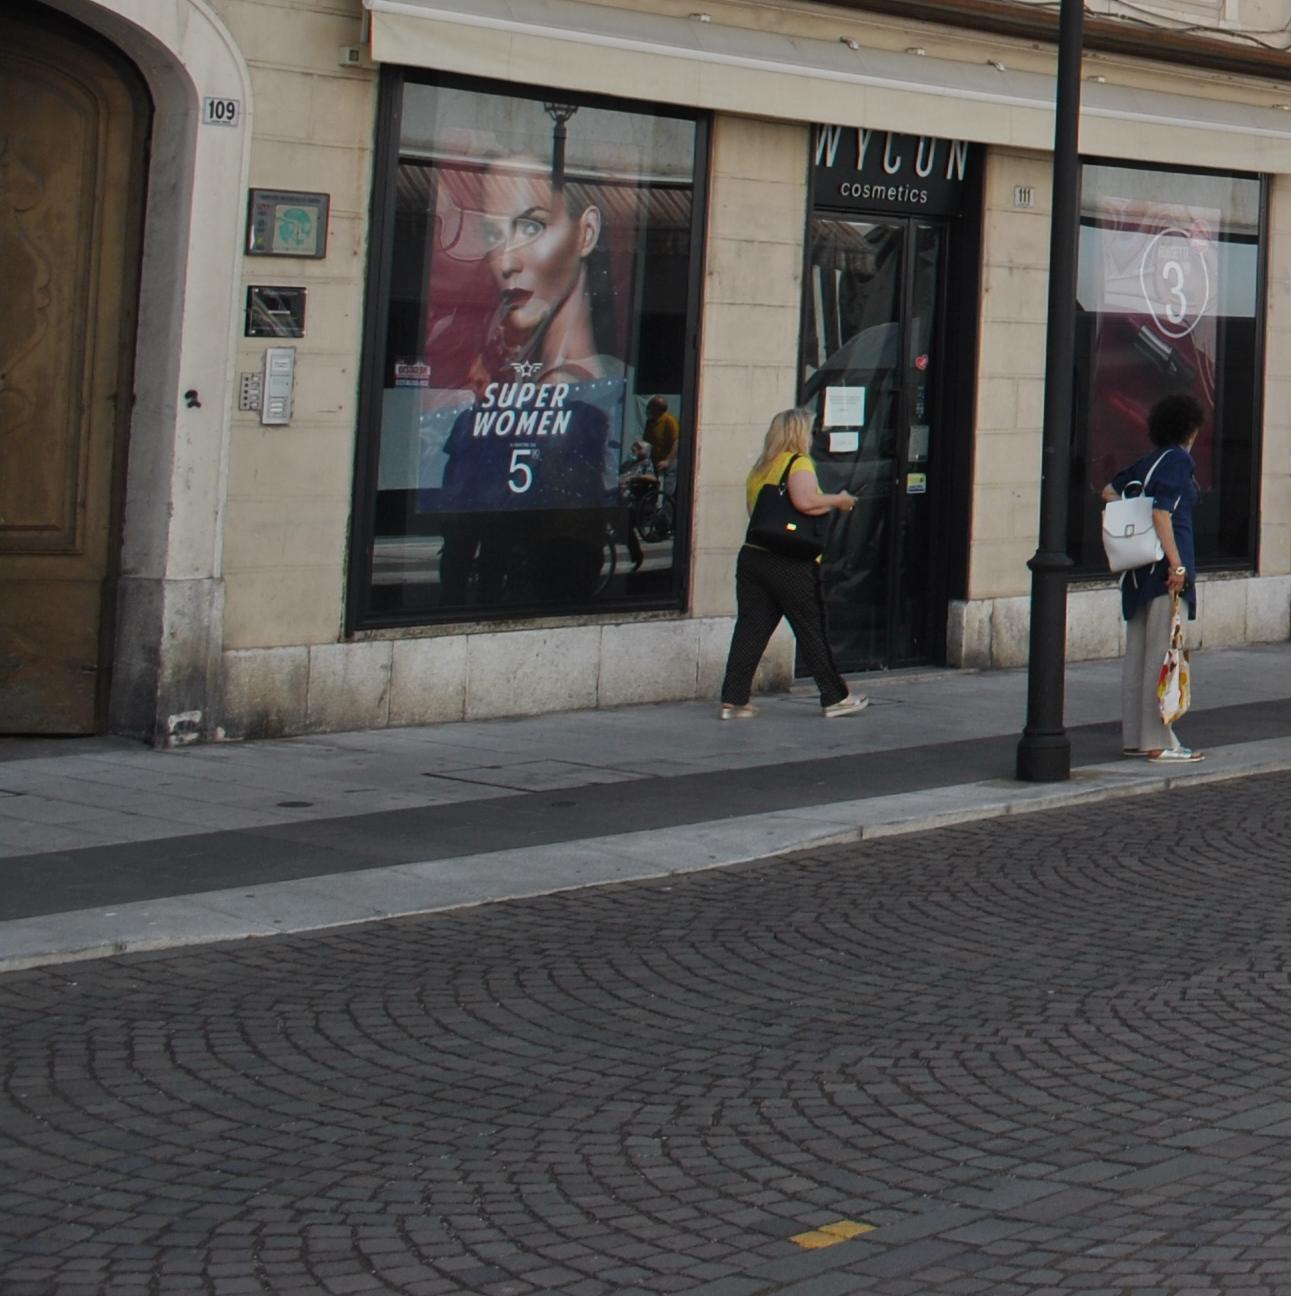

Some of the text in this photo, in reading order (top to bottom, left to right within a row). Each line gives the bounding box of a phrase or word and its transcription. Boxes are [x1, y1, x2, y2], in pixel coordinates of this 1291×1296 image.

[209, 100, 235, 120] 109
[840, 182, 928, 204] cosmetics
[1018, 188, 1032, 204] 111
[1163, 261, 1187, 324] 3
[482, 382, 569, 408] SUPER
[472, 409, 572, 437] WOMEN
[508, 449, 533, 493] 5
